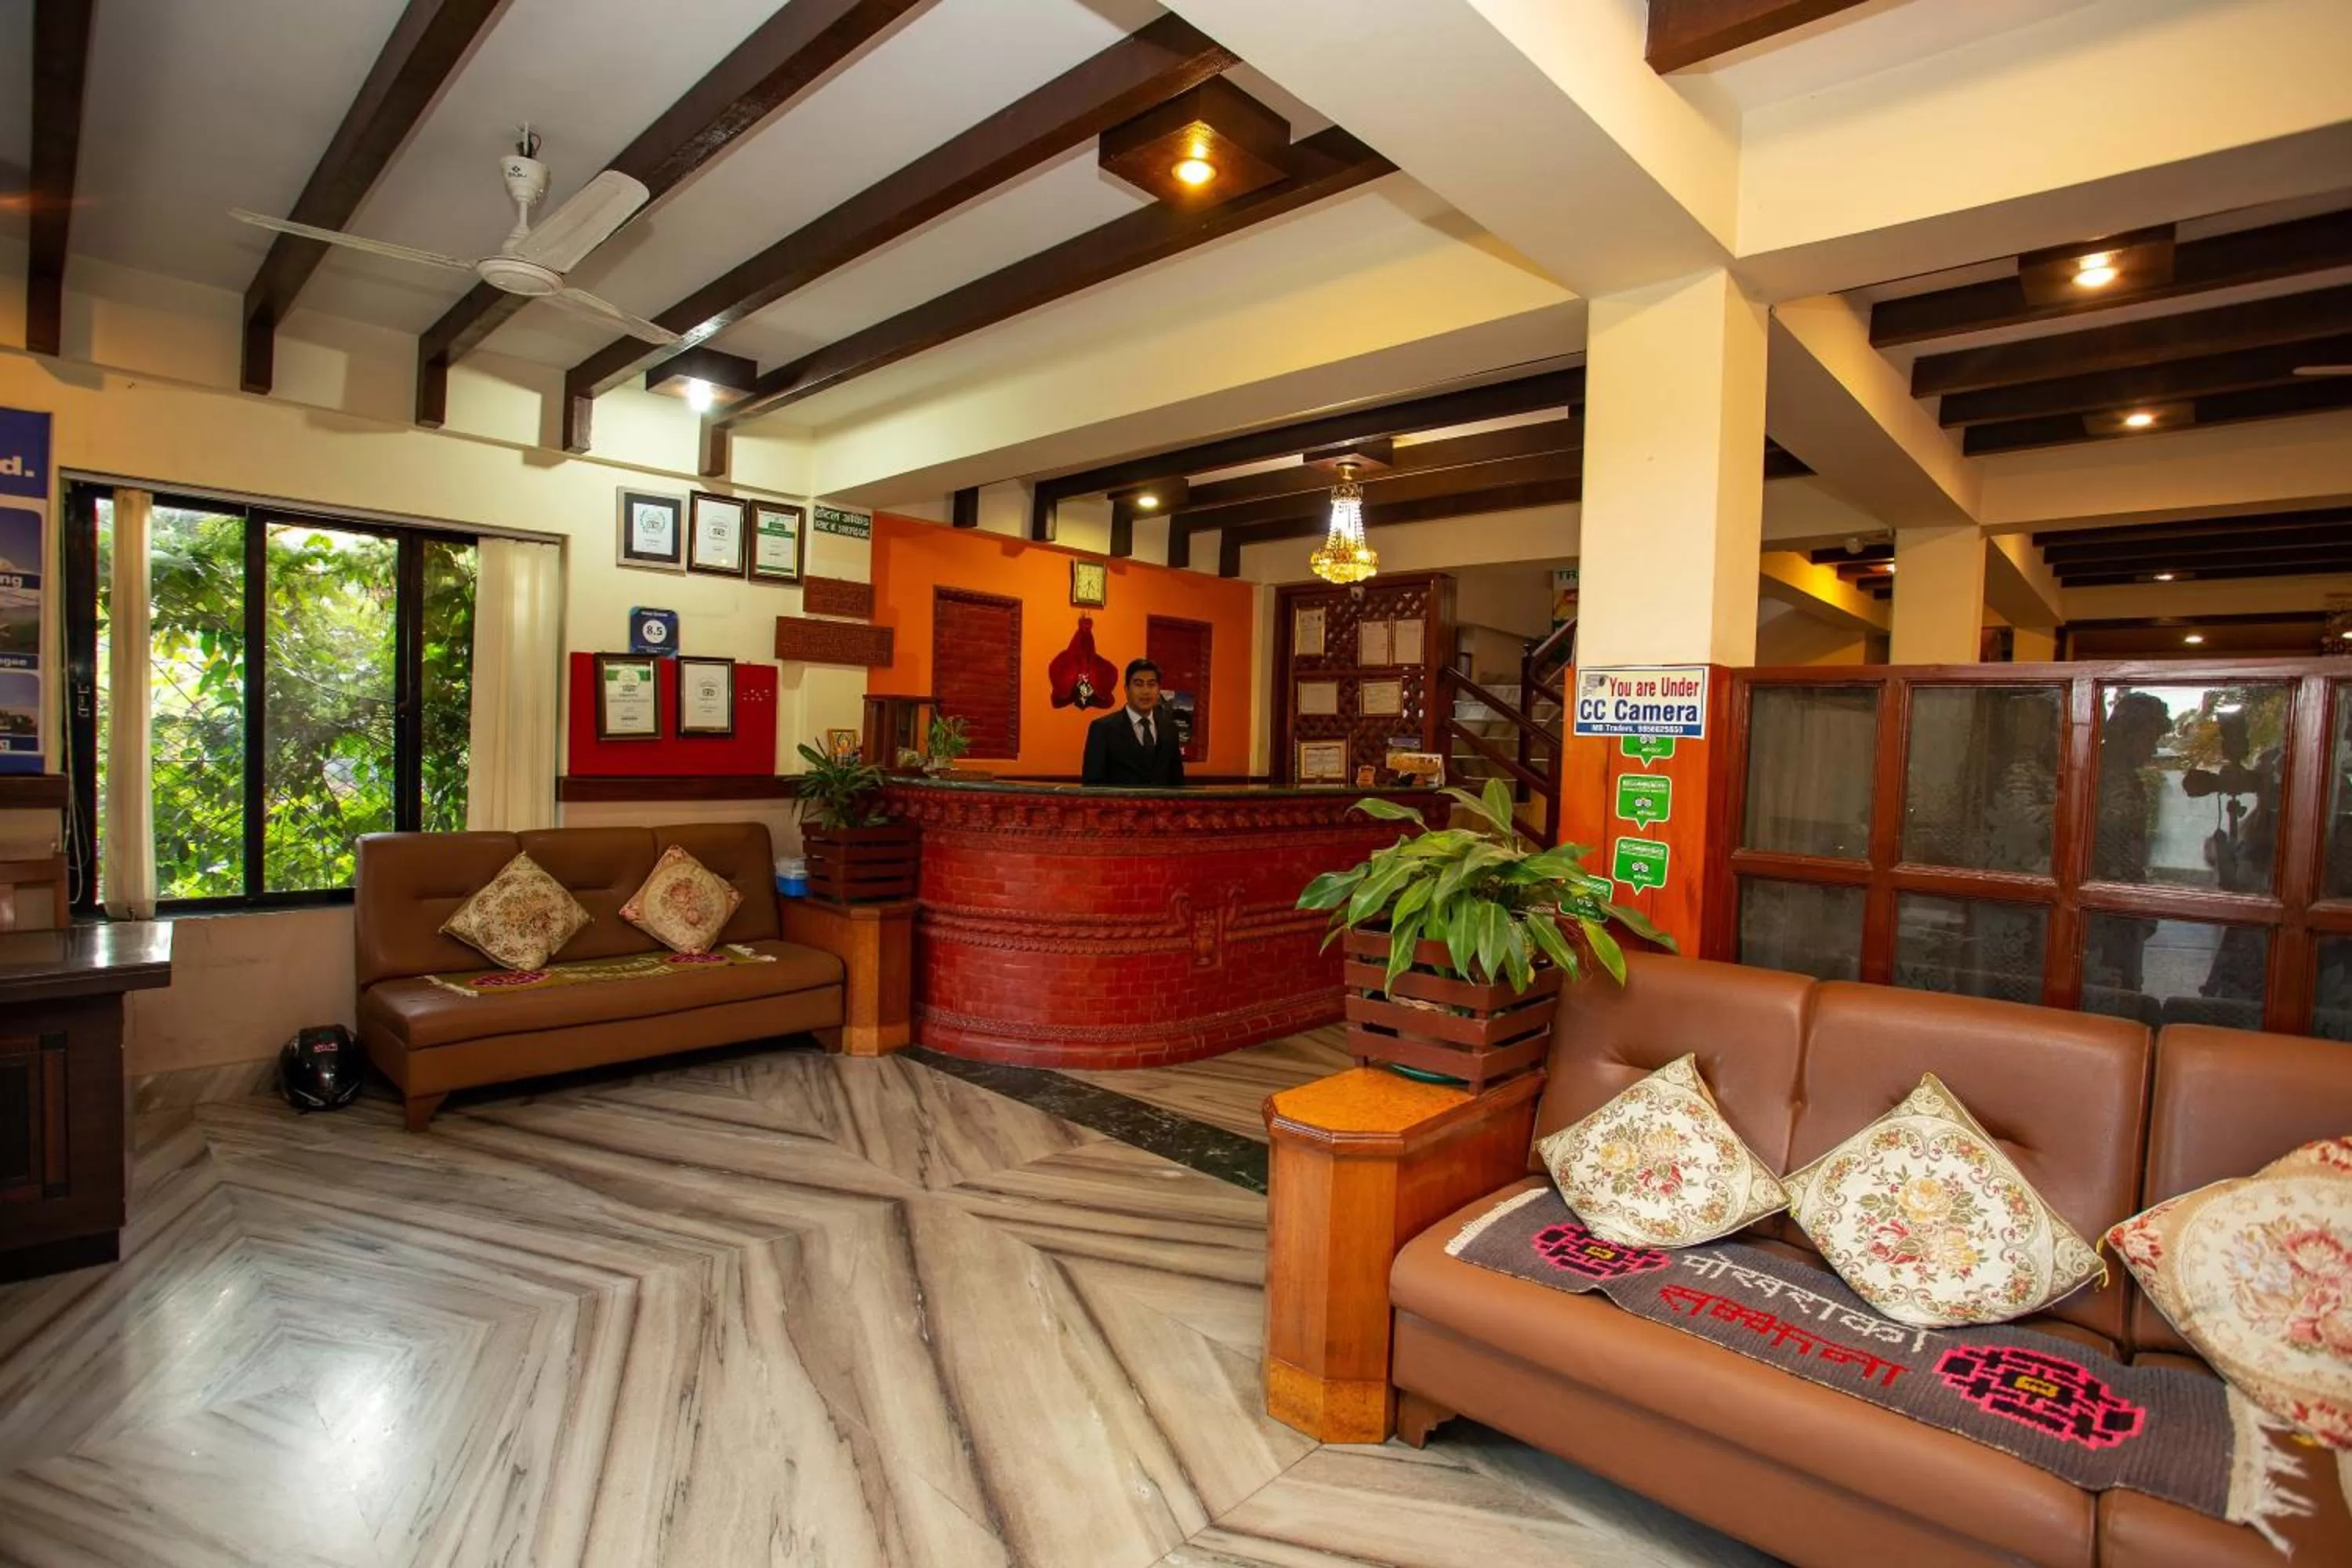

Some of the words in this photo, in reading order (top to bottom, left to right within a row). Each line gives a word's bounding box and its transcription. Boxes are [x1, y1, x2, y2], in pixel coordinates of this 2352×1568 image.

[647, 625, 662, 636] 8.5
[1610, 677, 1632, 697] You
[1636, 681, 1656, 697] are
[1661, 677, 1700, 697] Under
[1580, 699, 1606, 720] CC
[1615, 699, 1697, 722] Camera
